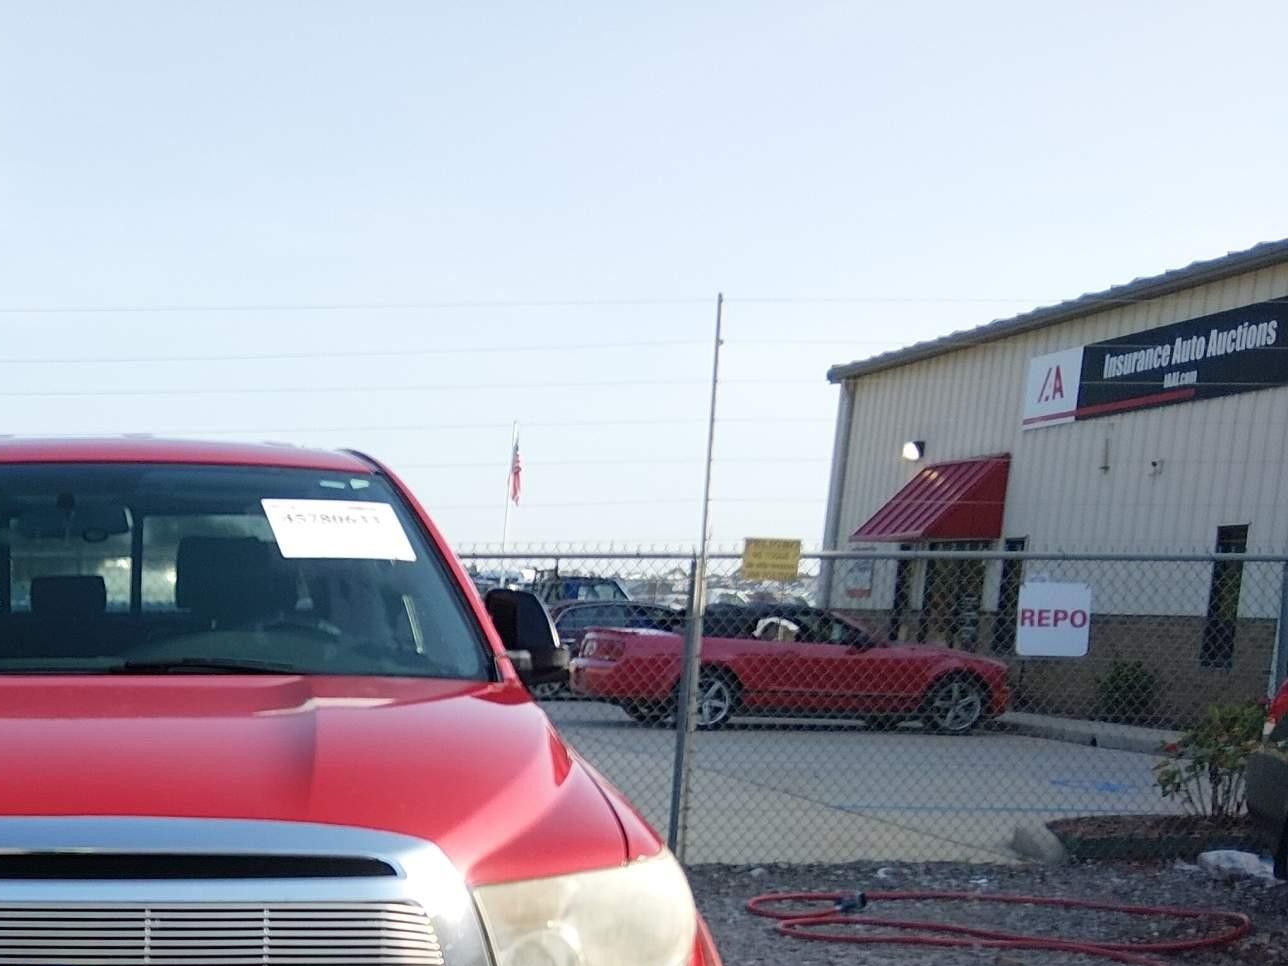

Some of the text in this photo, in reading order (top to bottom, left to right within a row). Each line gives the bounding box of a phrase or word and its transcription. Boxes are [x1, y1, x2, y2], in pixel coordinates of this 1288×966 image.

[1103, 320, 1279, 379] Insurance Auto Auctions
[1020, 608, 1088, 629] REPO
